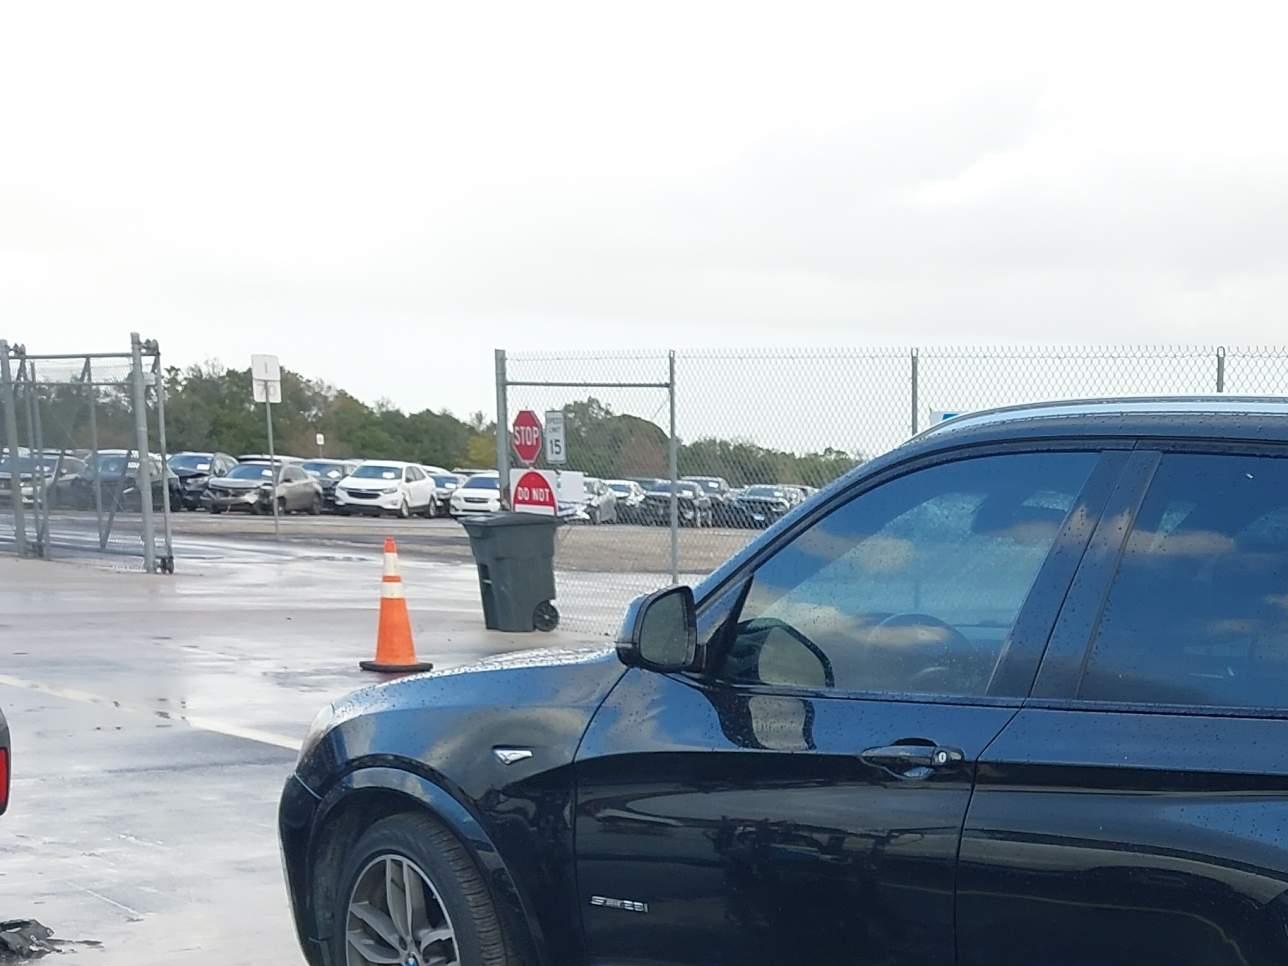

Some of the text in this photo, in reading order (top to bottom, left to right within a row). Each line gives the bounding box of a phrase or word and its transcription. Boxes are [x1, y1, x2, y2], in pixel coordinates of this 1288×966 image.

[514, 426, 540, 446] STOP
[549, 439, 562, 456] 15
[517, 487, 550, 502] DO NOT
